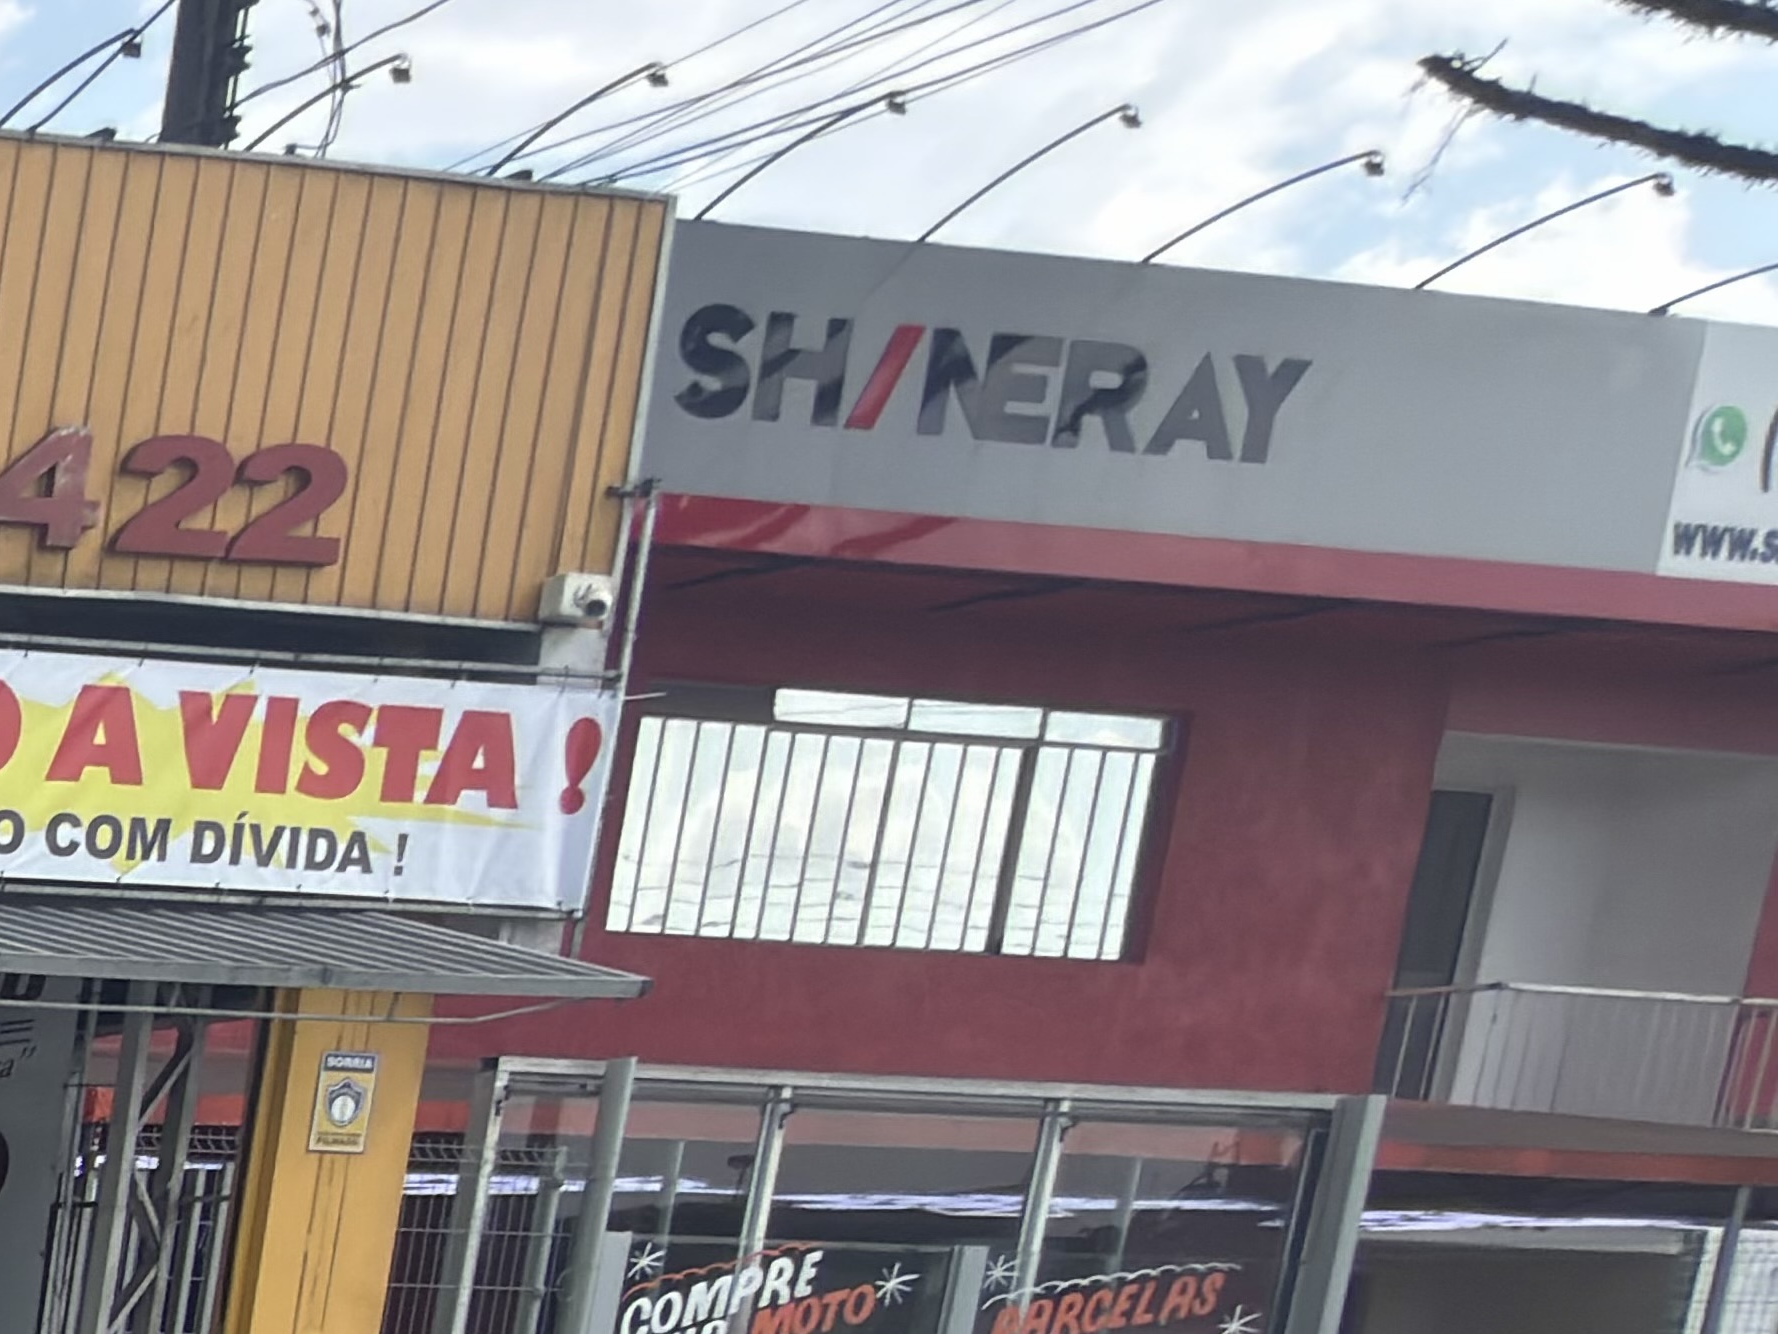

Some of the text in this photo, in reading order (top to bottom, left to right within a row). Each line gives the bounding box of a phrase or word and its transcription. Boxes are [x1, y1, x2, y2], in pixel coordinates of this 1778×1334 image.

[47, 684, 144, 788] A
[178, 690, 521, 811] VISTA
[559, 715, 604, 817] !
[44, 808, 171, 866] COM
[190, 810, 375, 876] DÍVIDA
[394, 832, 410, 877] !
[326, 1056, 373, 1069] SORRIA
